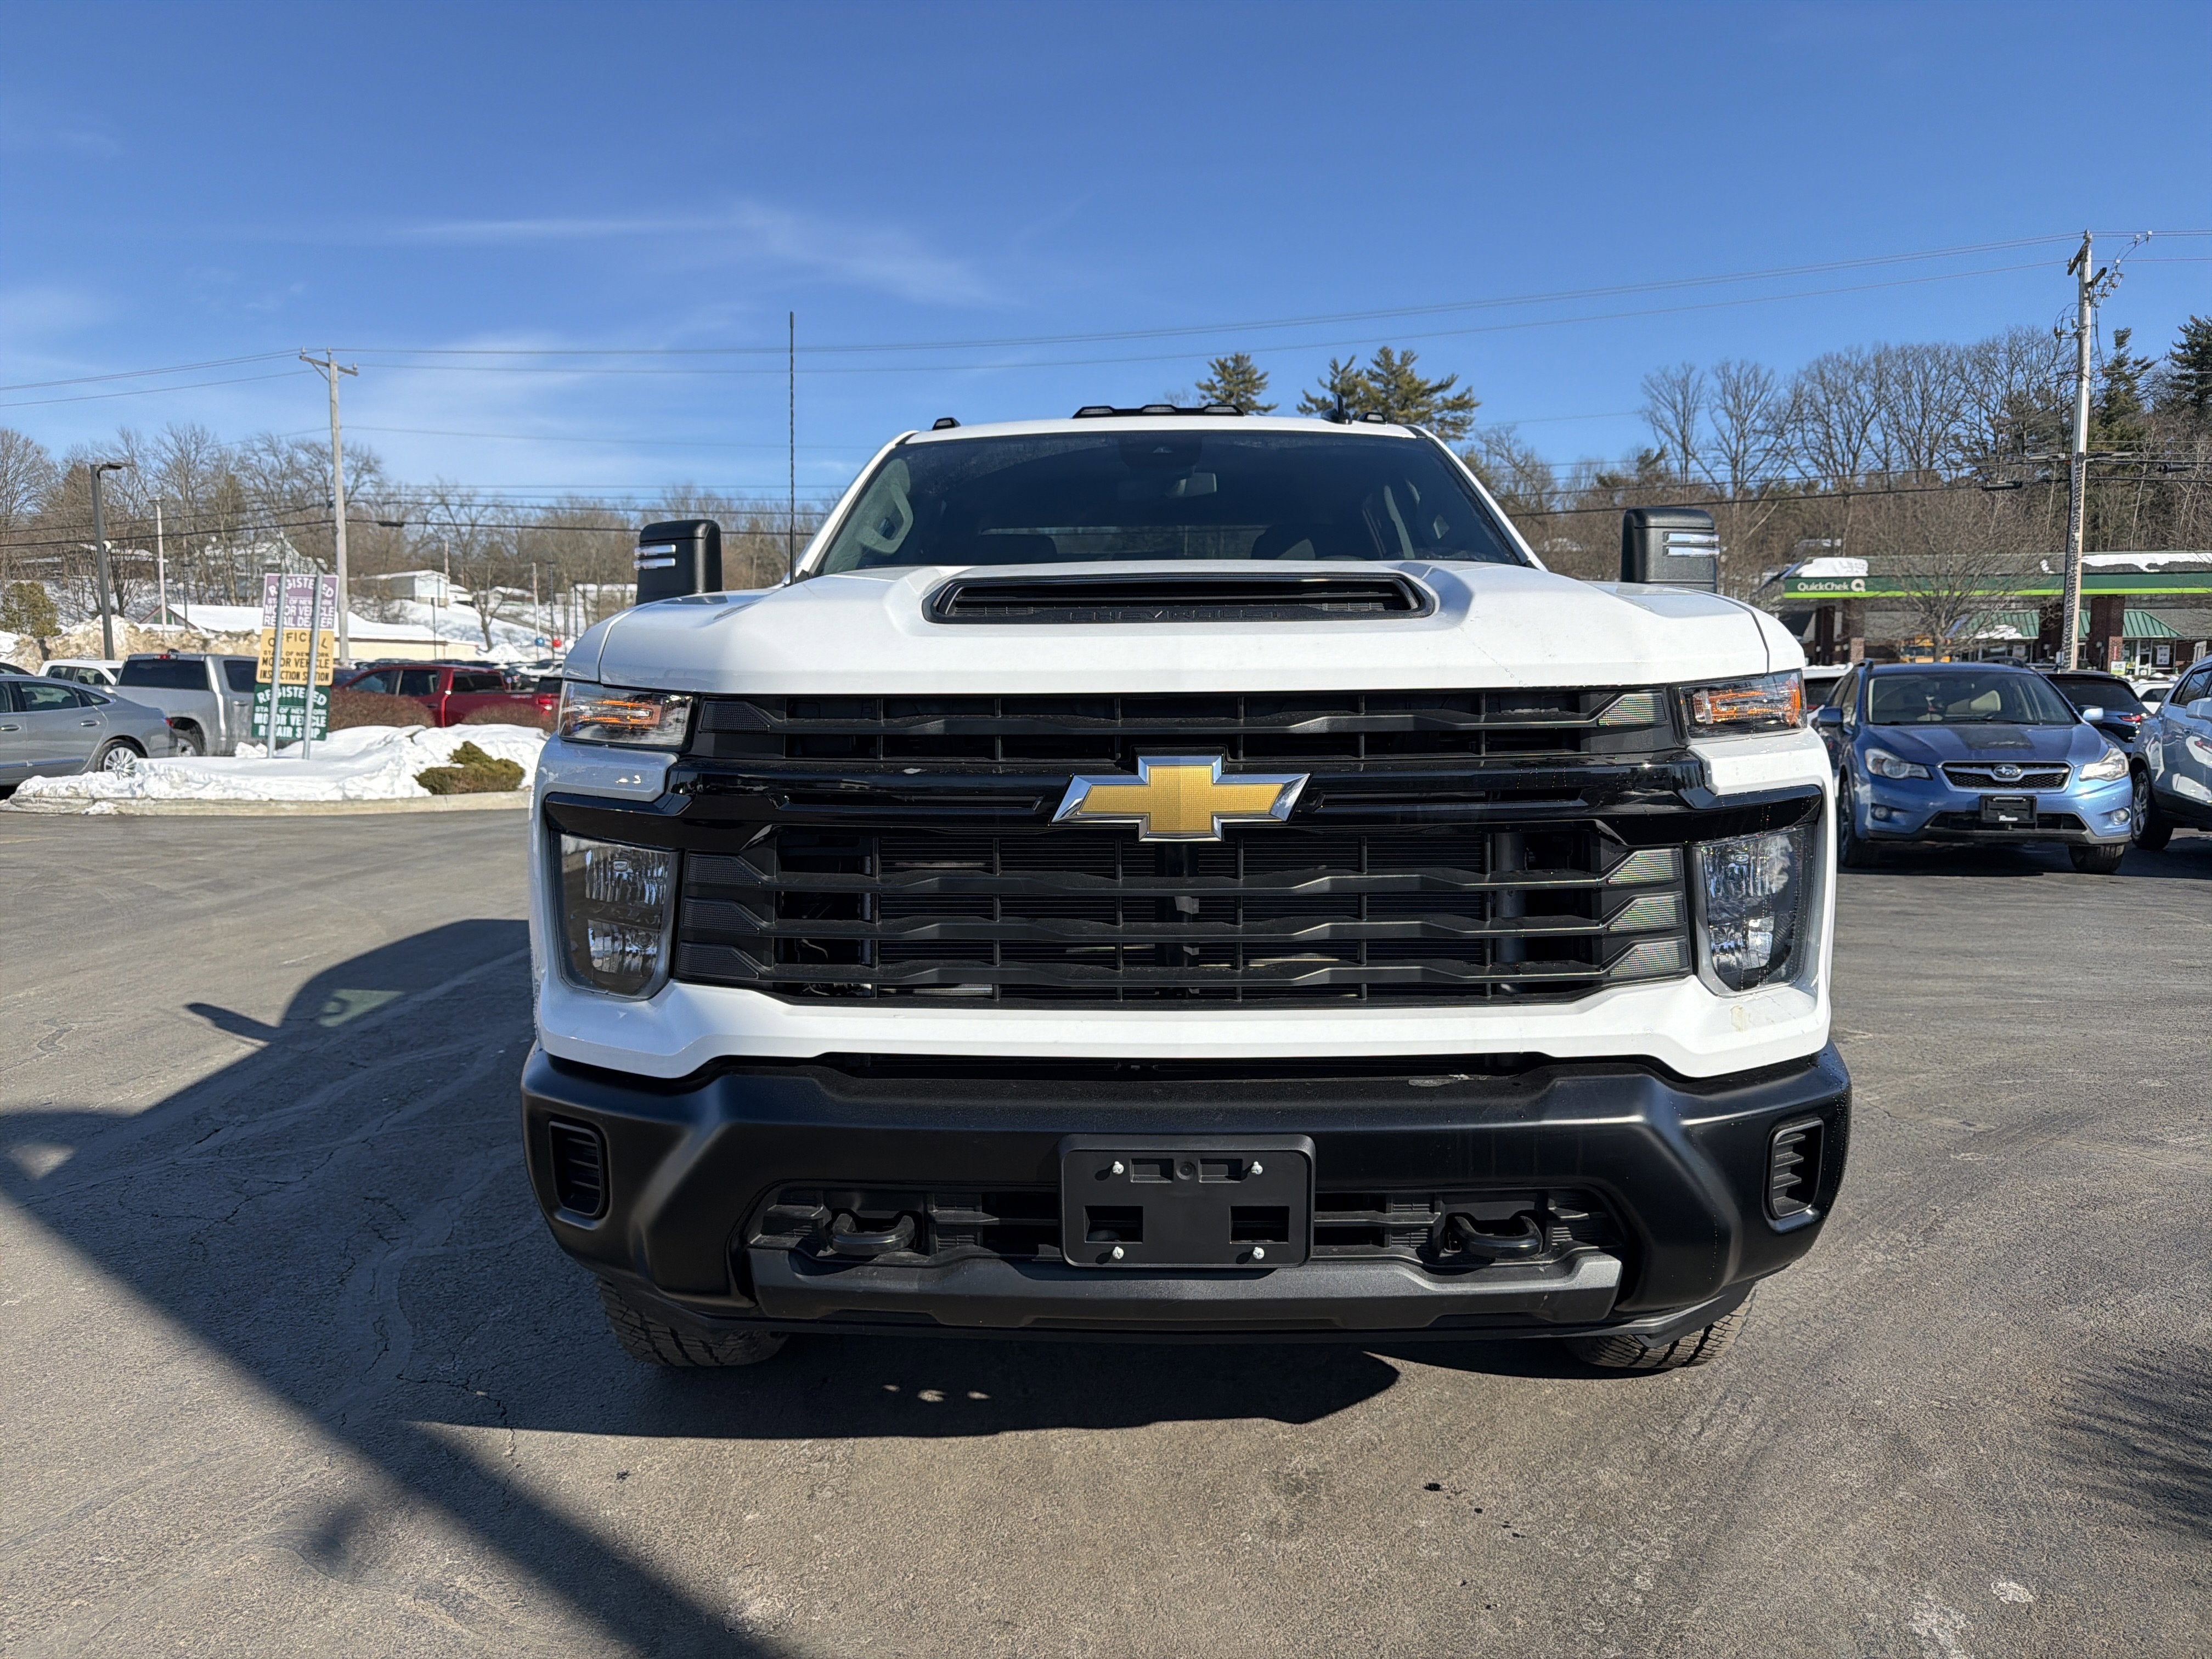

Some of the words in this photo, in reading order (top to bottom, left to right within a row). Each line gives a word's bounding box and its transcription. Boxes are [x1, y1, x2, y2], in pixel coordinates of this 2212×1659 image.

[1797, 582, 1849, 591] QuickChek
[264, 605, 297, 616] MOOR
[1069, 609, 1284, 620] CHEVROLET
[264, 614, 296, 627] REAIL
[297, 616, 333, 628] DEAER
[268, 632, 328, 649] OFICL
[262, 657, 291, 668] MOOR
[260, 669, 301, 681] INSCTION
[254, 713, 287, 725] MOOR
